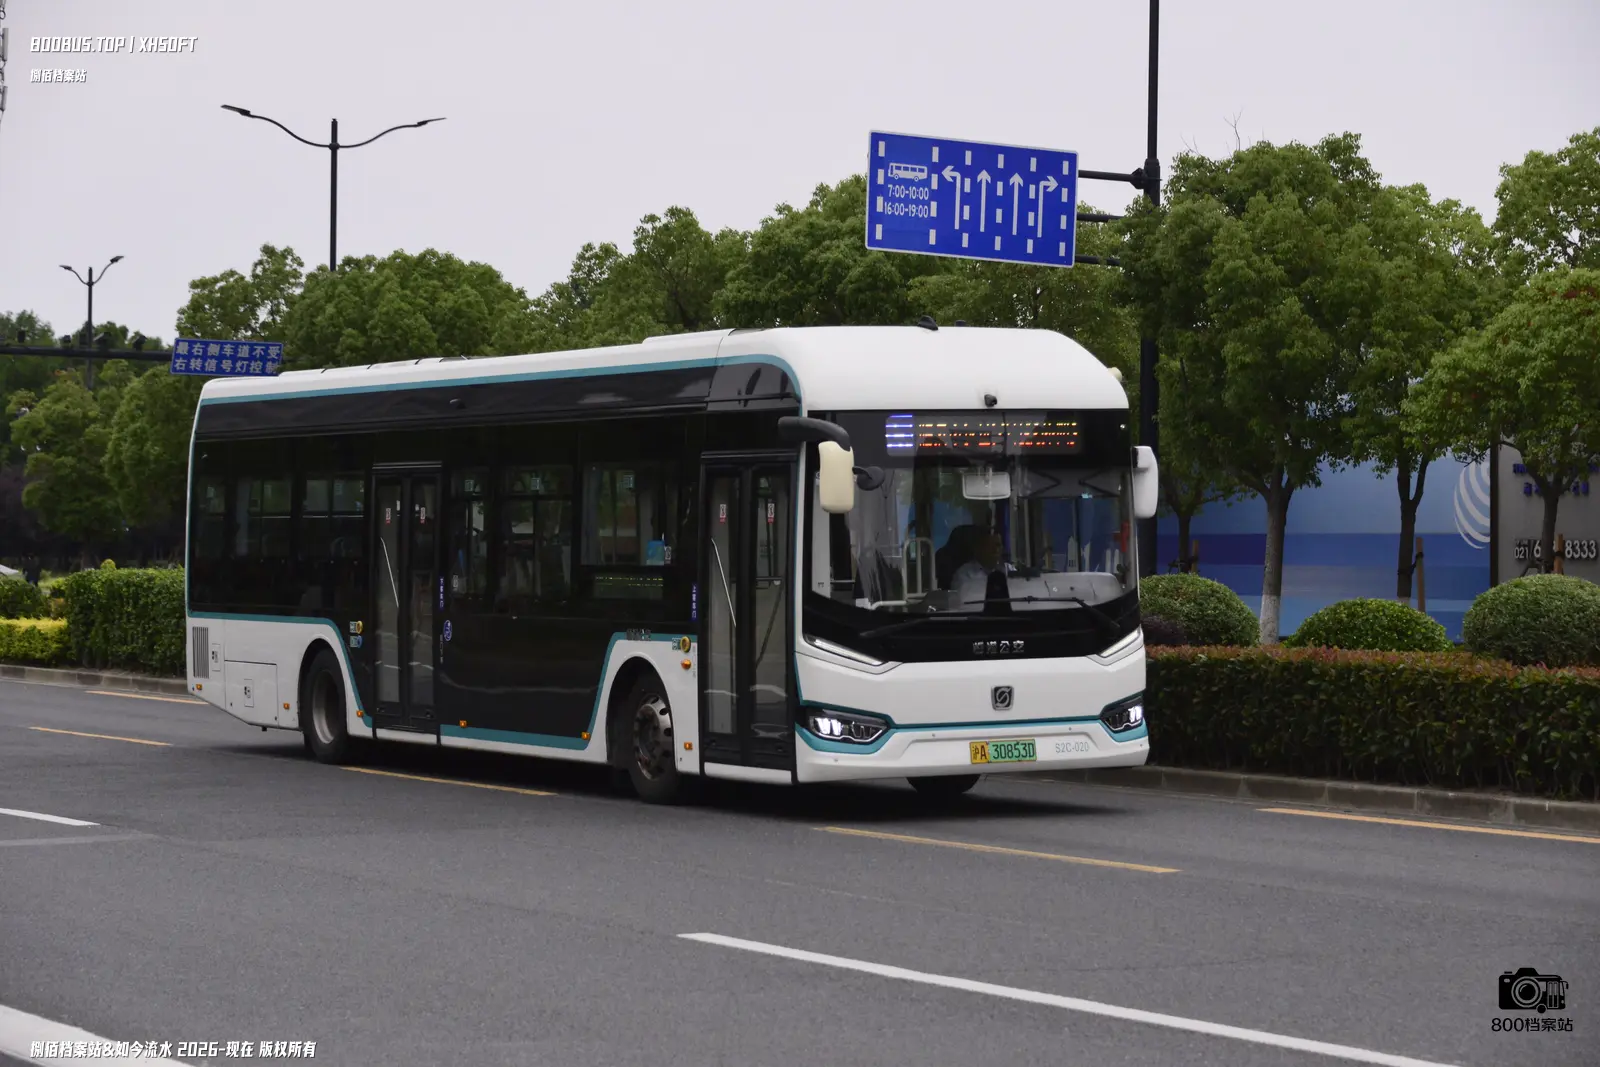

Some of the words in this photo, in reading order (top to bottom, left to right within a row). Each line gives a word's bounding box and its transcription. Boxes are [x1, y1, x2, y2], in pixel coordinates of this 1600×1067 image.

[888, 184, 929, 200] 7:00-10:00
[884, 201, 929, 218] 16:00-19:00
[175, 341, 280, 359] 最右侧车道不受
[174, 358, 279, 374] 右转信号灯控制
[1533, 540, 1597, 559] 68333
[992, 742, 1035, 760] 30853D
[1055, 741, 1090, 754] S2C-020
